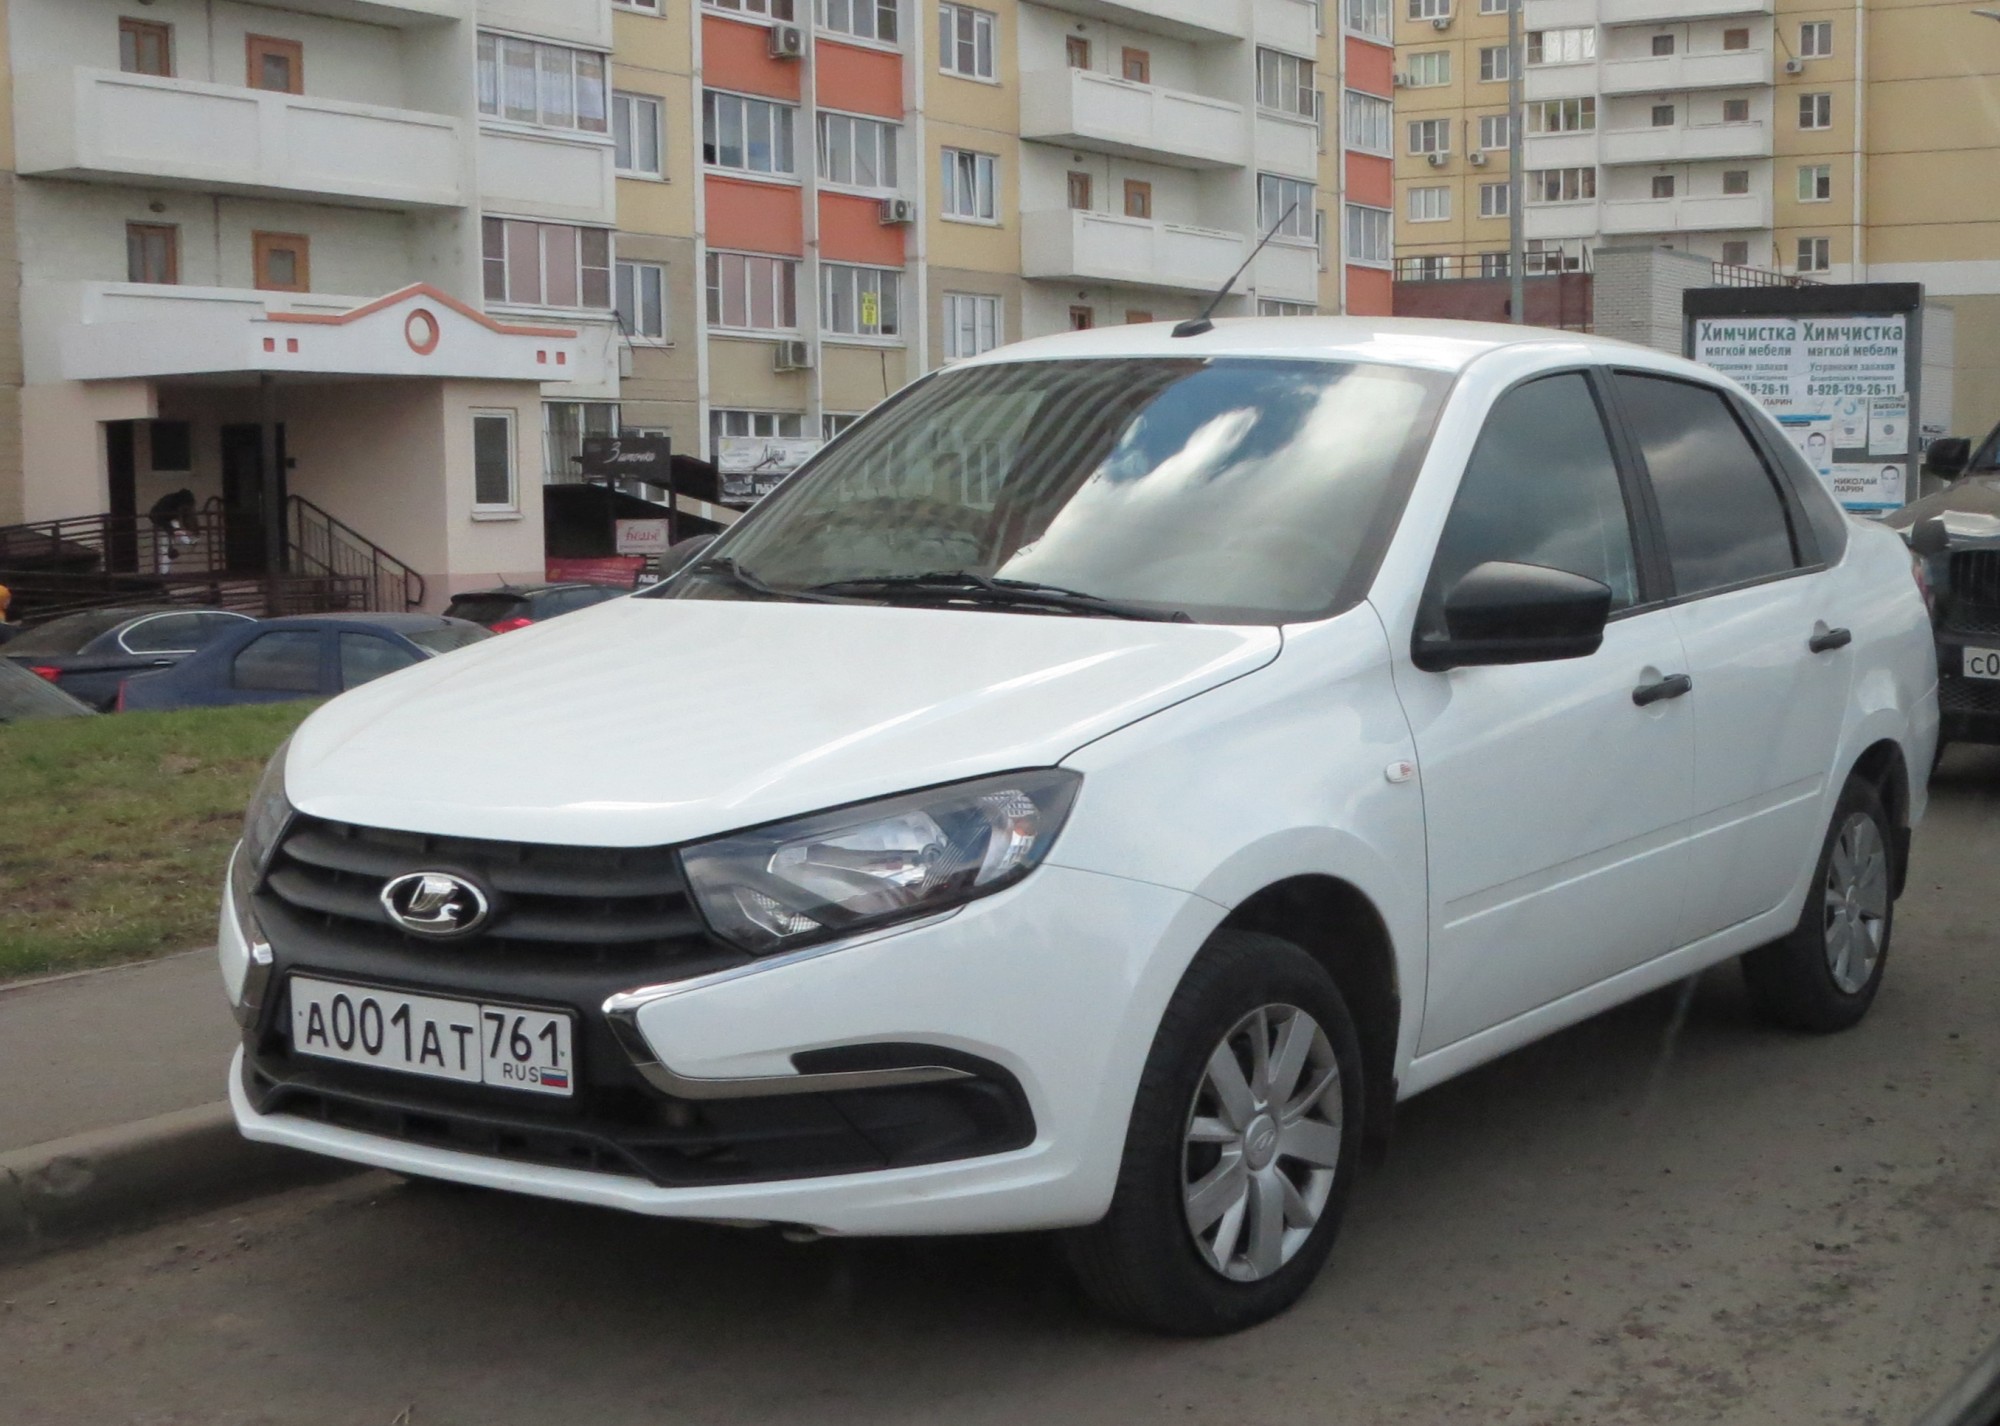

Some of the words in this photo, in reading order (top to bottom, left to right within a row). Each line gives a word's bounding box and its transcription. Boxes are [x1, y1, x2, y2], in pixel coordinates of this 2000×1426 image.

[1701, 322, 1796, 341] Химчистка
[1803, 322, 1903, 341] Химчистка
[1705, 345, 1745, 356] мягкой
[1748, 345, 1791, 356] мебели
[1807, 345, 1849, 356] мягкой
[1853, 344, 1898, 356] мебели
[1807, 383, 1897, 395] 8-928-129-26-11
[1834, 477, 1878, 485] НИКОЛАЙ
[306, 993, 474, 1070] А001АТ
[484, 1012, 558, 1067] 761
[502, 1062, 539, 1083] RUS
